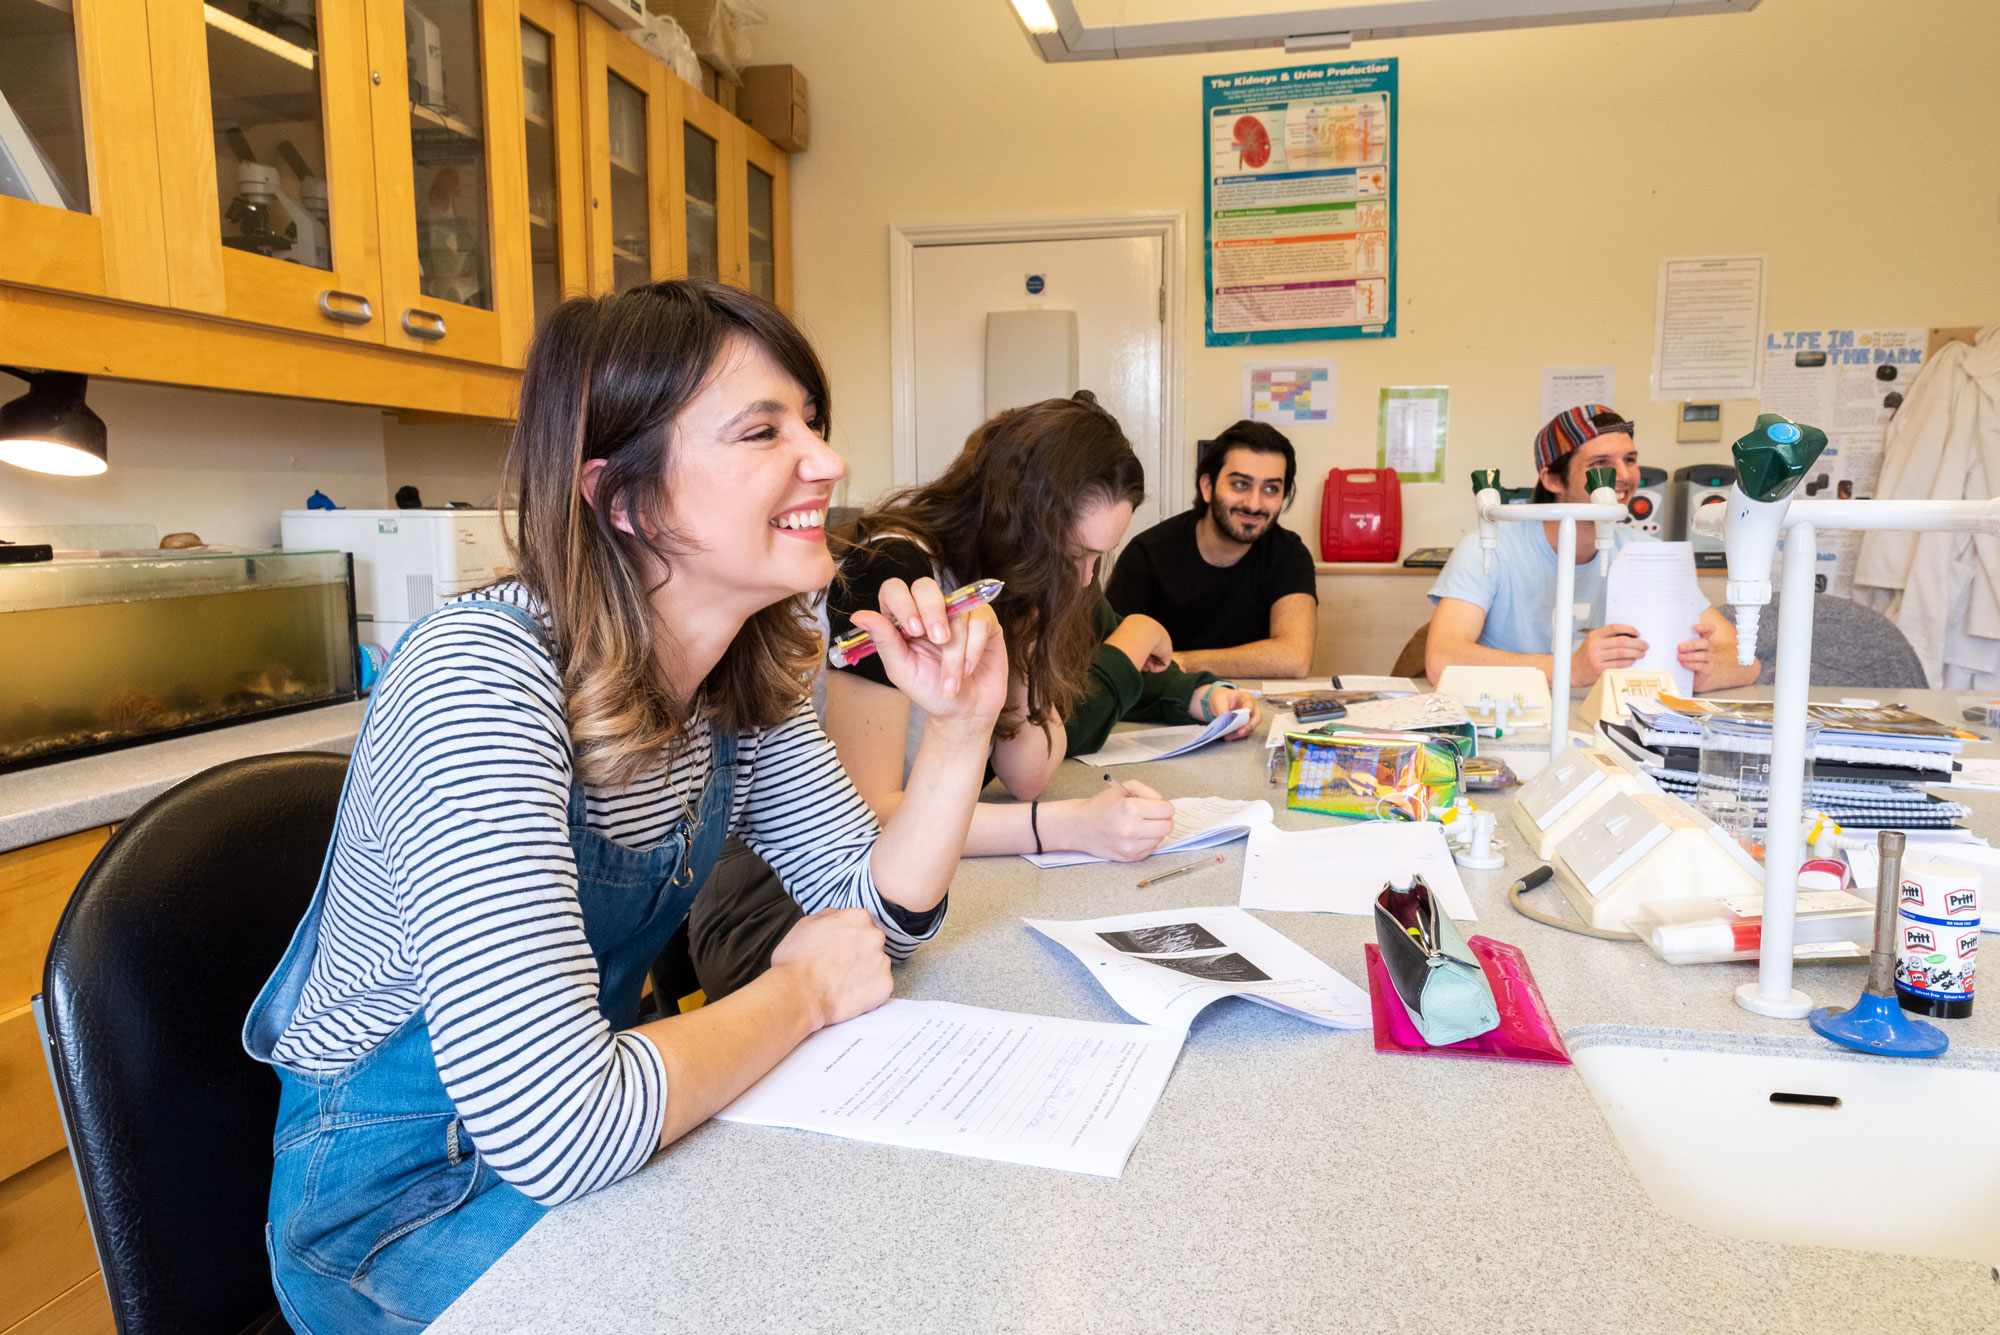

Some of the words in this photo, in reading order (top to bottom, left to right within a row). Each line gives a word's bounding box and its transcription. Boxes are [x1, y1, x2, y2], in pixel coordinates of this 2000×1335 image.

[1210, 79, 1231, 89] The
[1234, 75, 1277, 87] Kidneys
[1280, 72, 1290, 82] &
[1293, 70, 1324, 80] Urine
[1327, 64, 1389, 77] Production
[1767, 331, 1822, 350] LIFE
[1827, 330, 1854, 349] IN
[1828, 348, 1871, 365] THE
[1874, 348, 1922, 364] DARK
[1949, 893, 1973, 906] Pritt
[1907, 931, 1930, 944] Pritt
